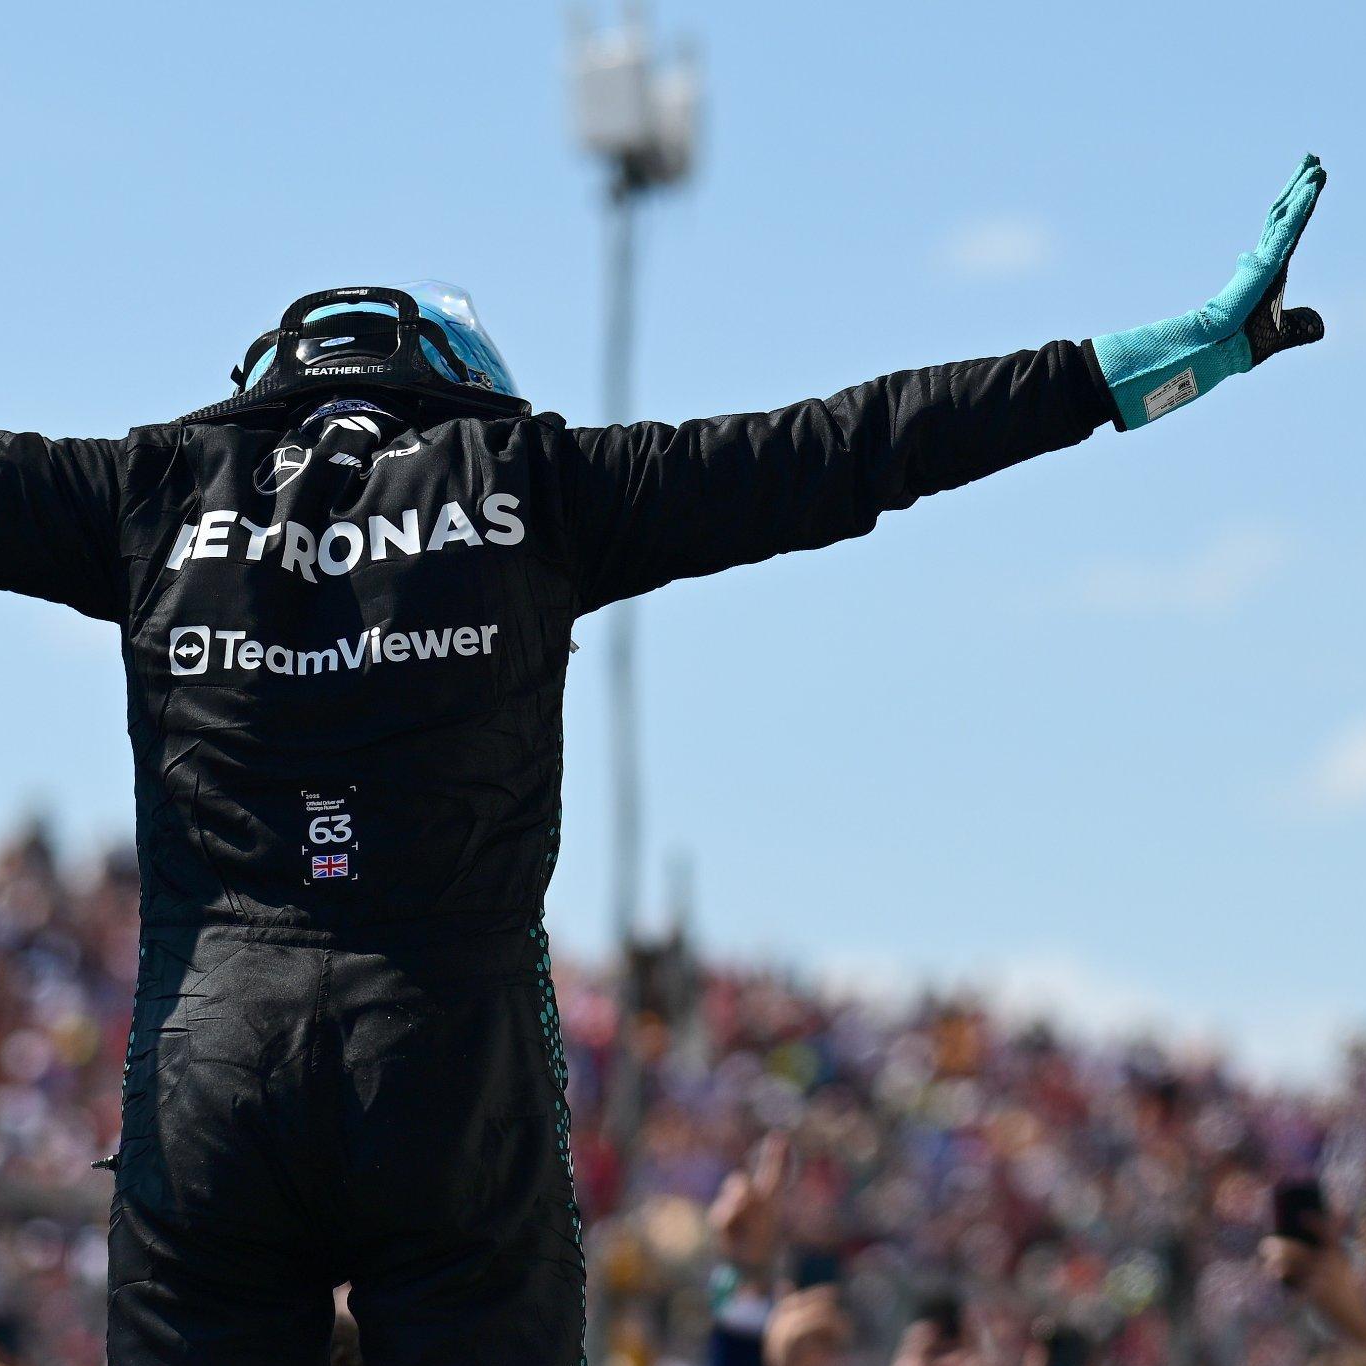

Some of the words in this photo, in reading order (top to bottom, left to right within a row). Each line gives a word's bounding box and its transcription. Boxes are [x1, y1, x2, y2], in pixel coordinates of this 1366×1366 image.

[305, 365, 384, 376] FEATHERLITE
[215, 624, 499, 676] TeamViewer
[308, 813, 353, 845] 63
